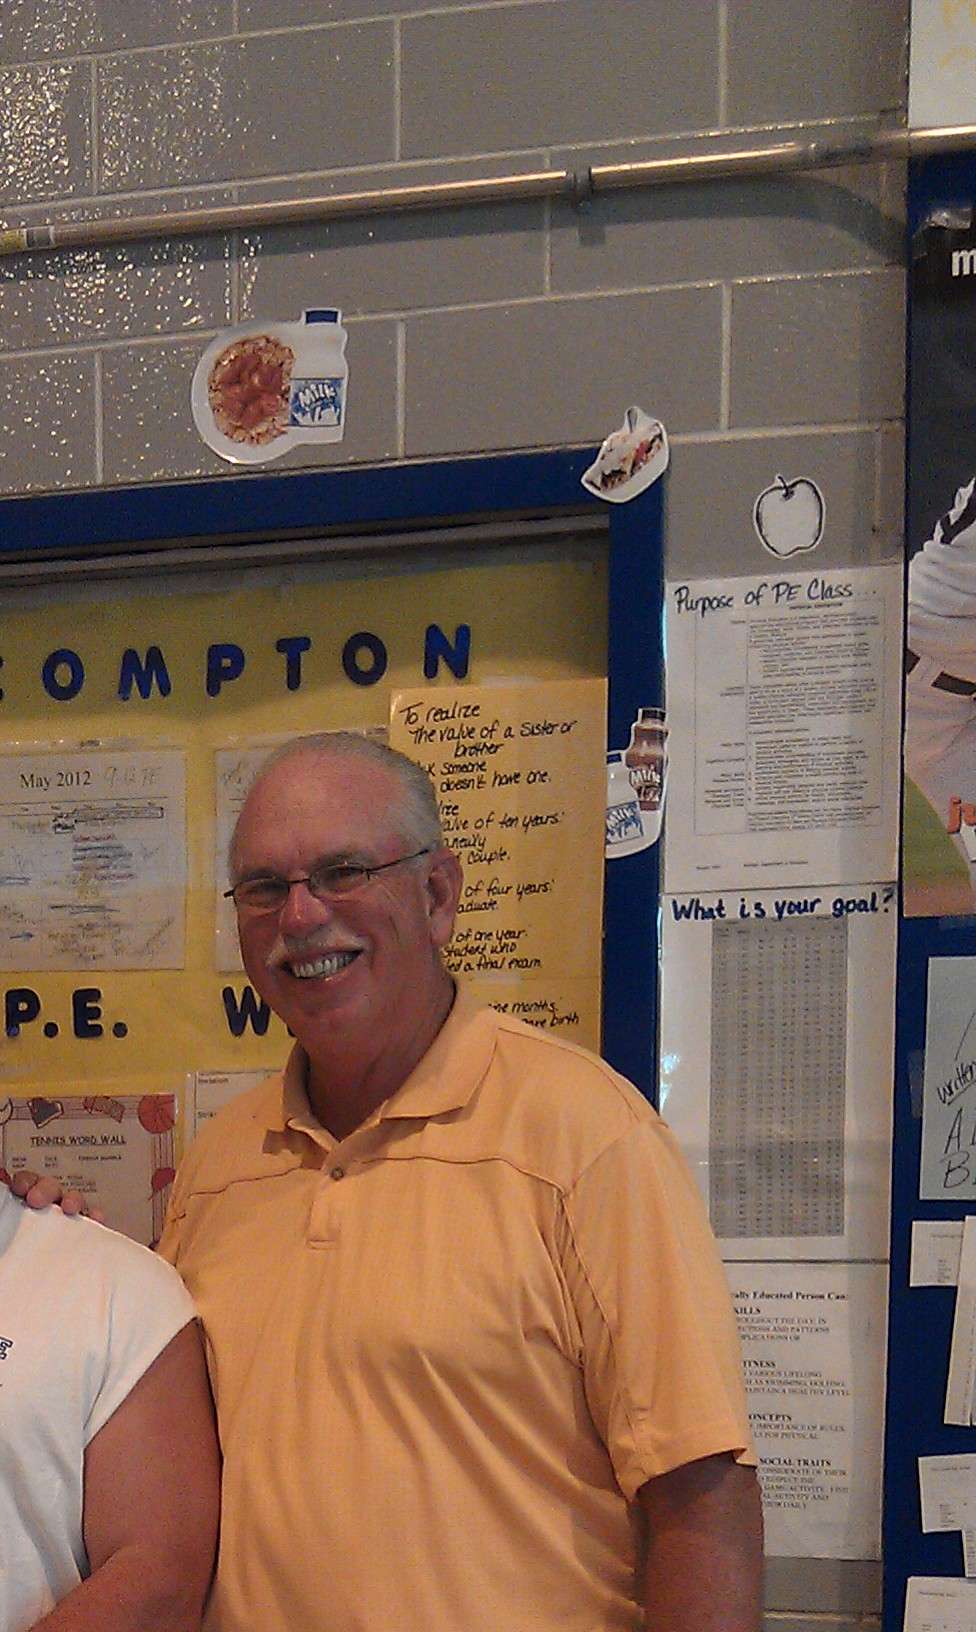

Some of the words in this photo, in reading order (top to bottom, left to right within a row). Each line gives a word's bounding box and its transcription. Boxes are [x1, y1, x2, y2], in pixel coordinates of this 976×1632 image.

[298, 381, 336, 408] Milk
[674, 586, 735, 618] Purpose
[744, 583, 768, 606] of
[772, 582, 802, 604] PE
[399, 702, 423, 725] To
[426, 701, 481, 723] realize
[439, 724, 475, 743] value
[480, 721, 499, 739] of
[504, 729, 514, 738] a
[560, 721, 577, 735] or
[454, 743, 504, 758] brother
[20, 773, 52, 791] May
[57, 770, 92, 787] 2012
[493, 771, 521, 787] have
[474, 812, 494, 831] of
[499, 813, 519, 829] ten
[465, 880, 483, 898] of
[672, 898, 727, 921] What
[739, 897, 766, 920] is
[774, 898, 823, 922] your
[832, 888, 894, 920] goal?
[456, 928, 472, 943] of
[5, 988, 129, 1038] P.E.
[945, 1107, 962, 1154] A
[30, 1136, 66, 1147] TENNIS
[101, 1135, 126, 1145] WALL
[753, 1291, 793, 1300] Educated
[795, 1291, 825, 1300] Person
[743, 1360, 776, 1368] ITNESS
[748, 1413, 792, 1421] ONCEPTS
[759, 1457, 793, 1465] SOCIAL
[797, 1458, 831, 1466] TRAITS
